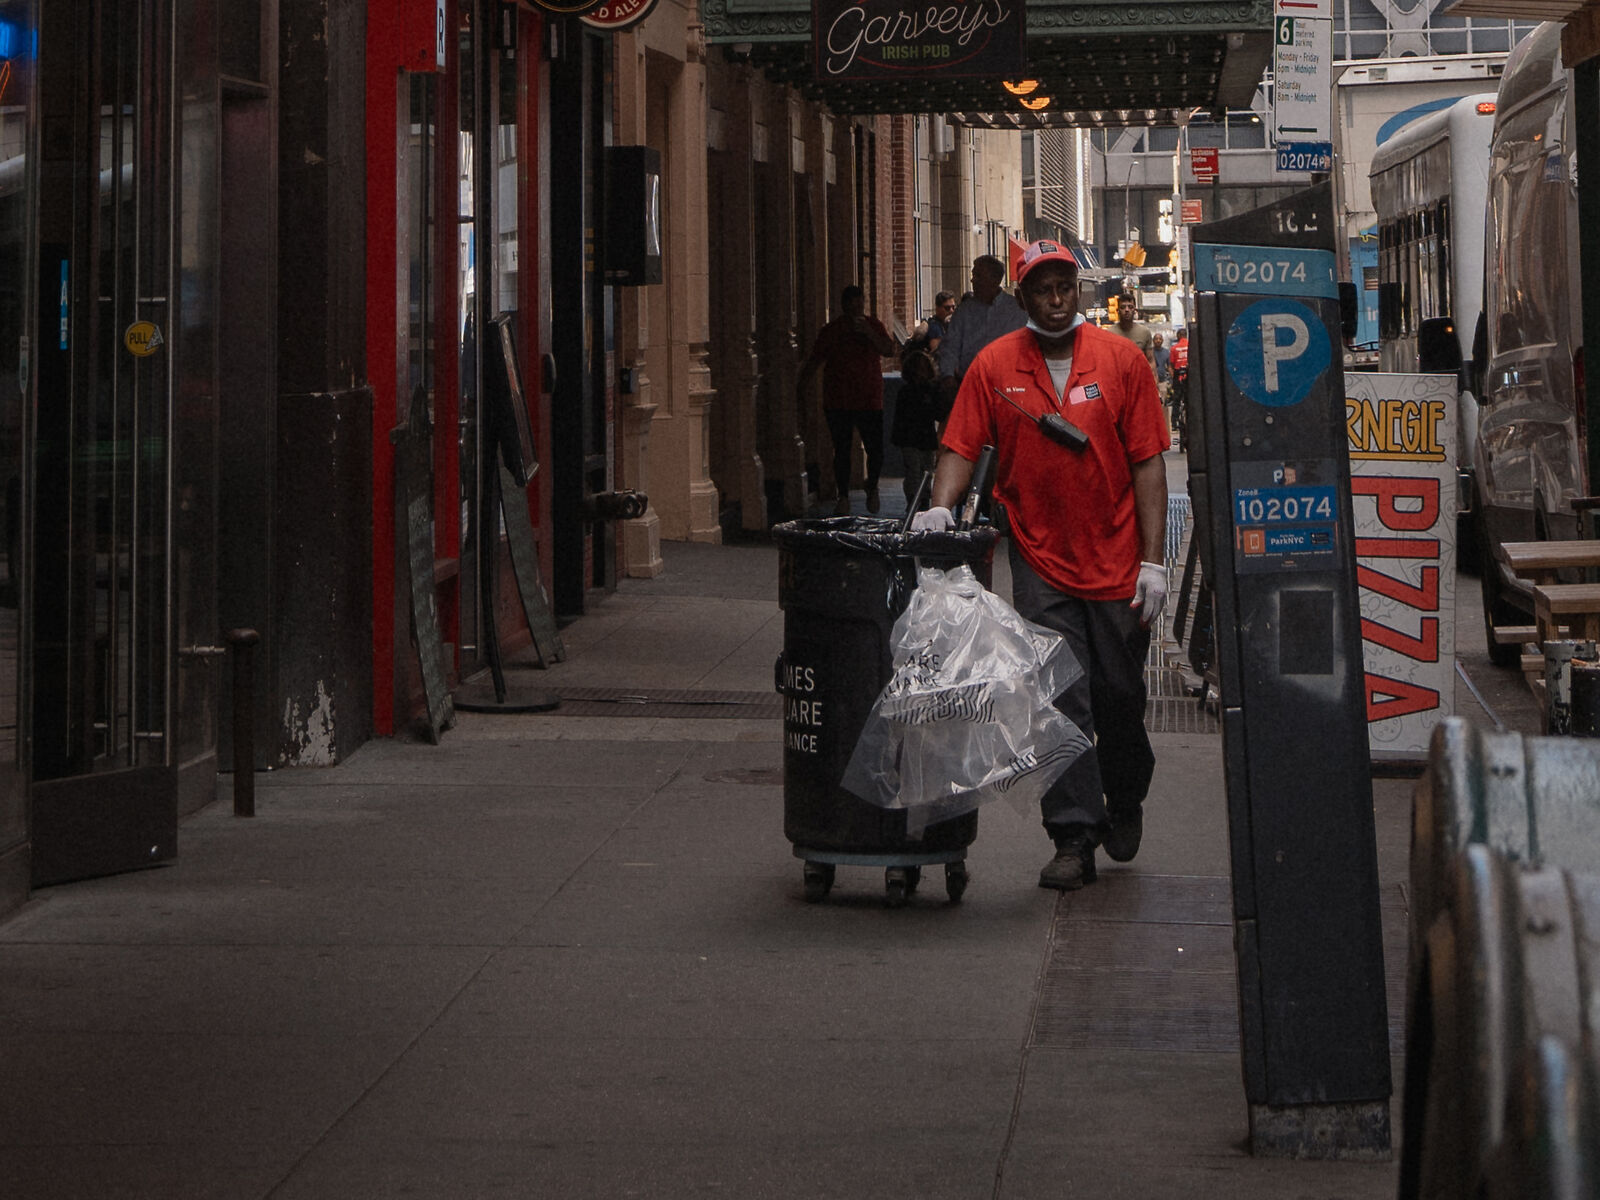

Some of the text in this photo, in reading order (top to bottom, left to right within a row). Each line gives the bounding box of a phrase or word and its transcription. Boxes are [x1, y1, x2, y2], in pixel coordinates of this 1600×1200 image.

[1280, 18, 1290, 44] 6
[882, 45, 950, 60] IRISH PUB
[1277, 51, 1299, 63] Monday
[1303, 52, 1320, 64] Friday
[1294, 64, 1317, 75] Midnight
[1277, 79, 1301, 91] Saturday
[1294, 92, 1317, 103] Midnight
[1277, 152, 1318, 169] 102074
[1215, 261, 1306, 284] 102074
[1261, 313, 1310, 393] P
[1239, 495, 1332, 521] 102074
[1270, 536, 1304, 545] ParkNYC
[1351, 476, 1441, 723] PIZZA
